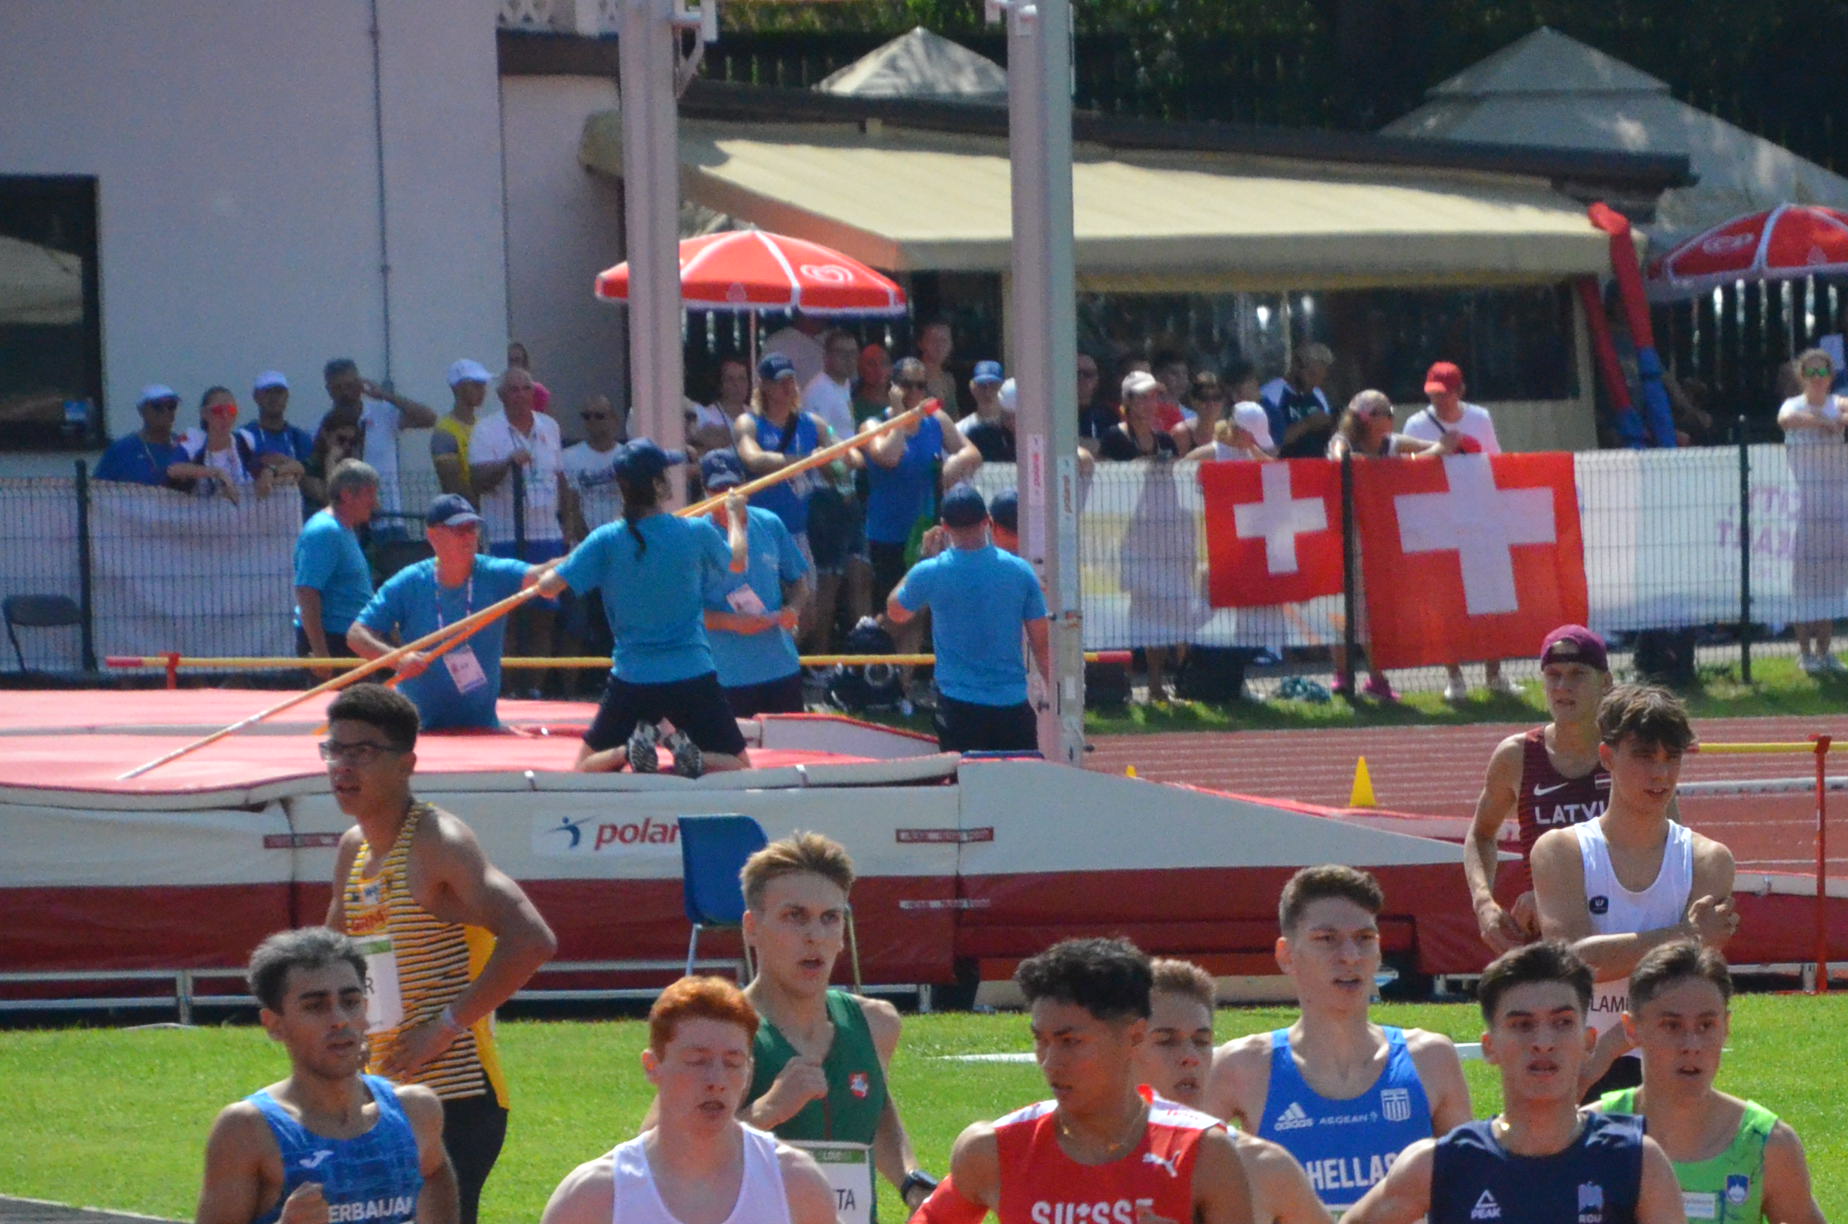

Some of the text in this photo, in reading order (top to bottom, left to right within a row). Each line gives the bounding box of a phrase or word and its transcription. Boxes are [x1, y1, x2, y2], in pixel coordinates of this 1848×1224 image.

[1534, 801, 1605, 825] LATVI
[328, 1196, 413, 1223] ERBAIJA
[1471, 1208, 1501, 1220] PEAK
